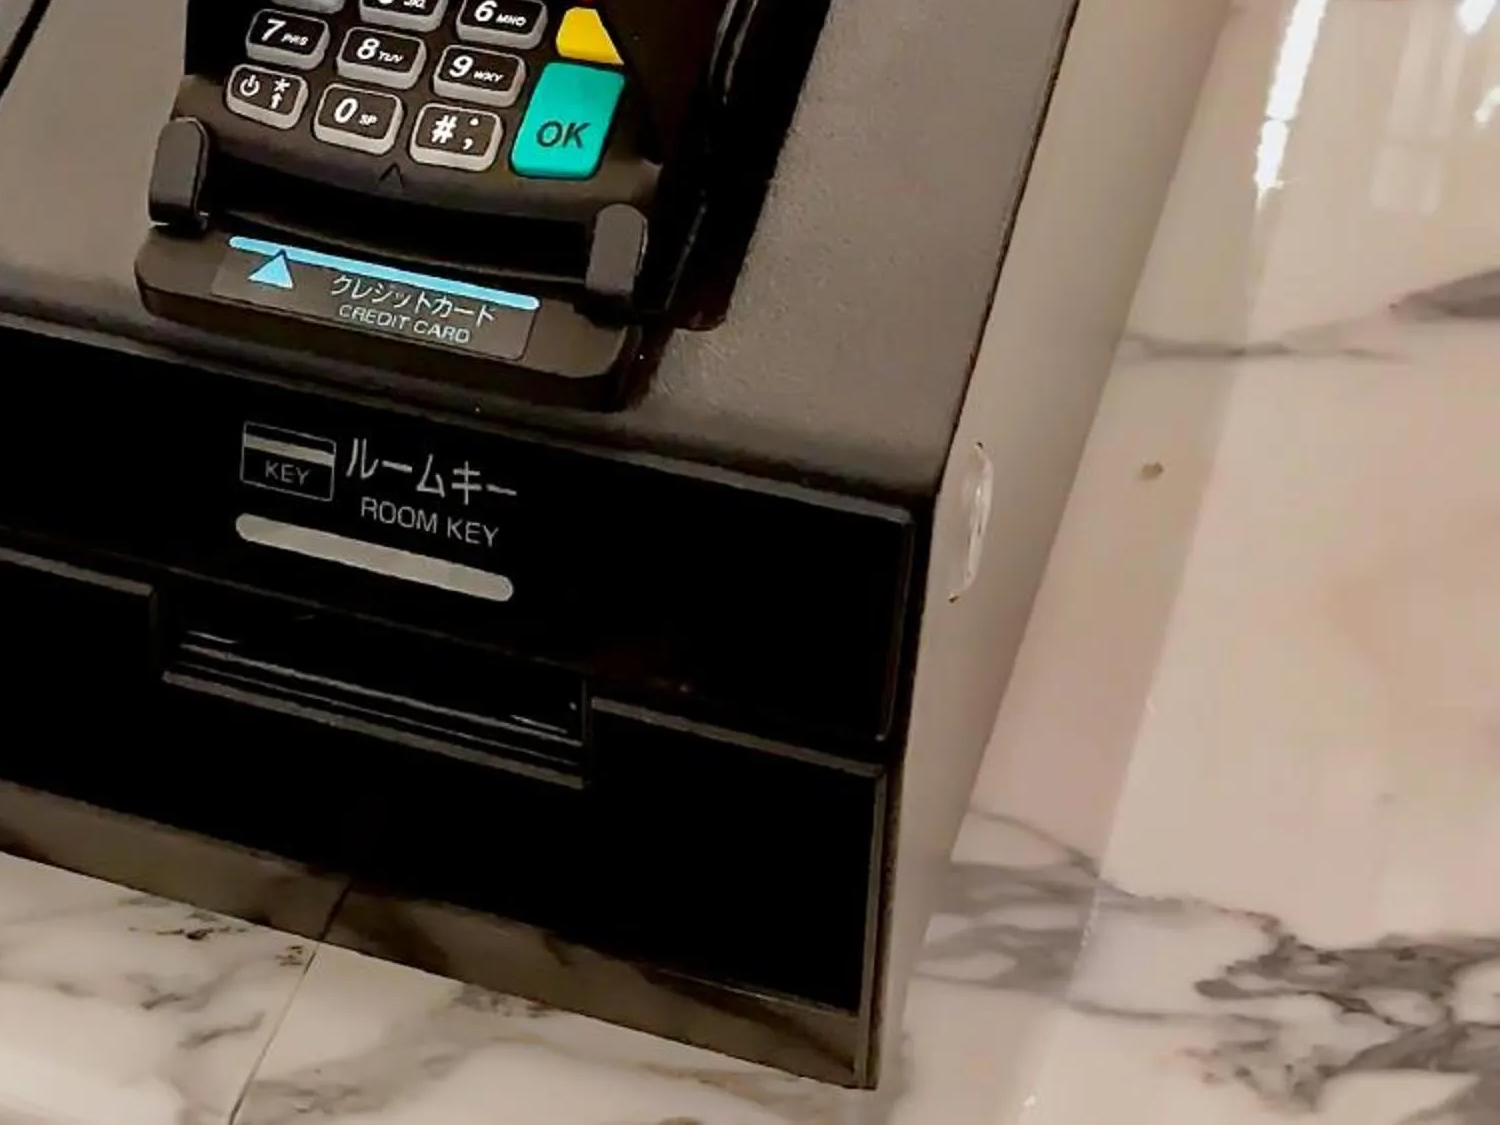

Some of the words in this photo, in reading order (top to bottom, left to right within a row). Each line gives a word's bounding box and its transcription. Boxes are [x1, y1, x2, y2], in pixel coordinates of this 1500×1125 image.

[474, 0, 498, 22] 6
[496, 13, 527, 27] MNO
[261, 18, 287, 42] 7
[356, 38, 381, 60] 8
[378, 50, 405, 63] TUV
[449, 55, 474, 78] 9
[334, 98, 359, 124] 0
[431, 114, 458, 144] #
[536, 121, 591, 149] OK
[338, 304, 408, 331] CREDIT
[413, 319, 472, 344] CARD
[264, 459, 312, 486] KEY
[345, 437, 518, 506] ルームキー
[360, 496, 439, 535] ROOM
[447, 516, 500, 548] KEY
